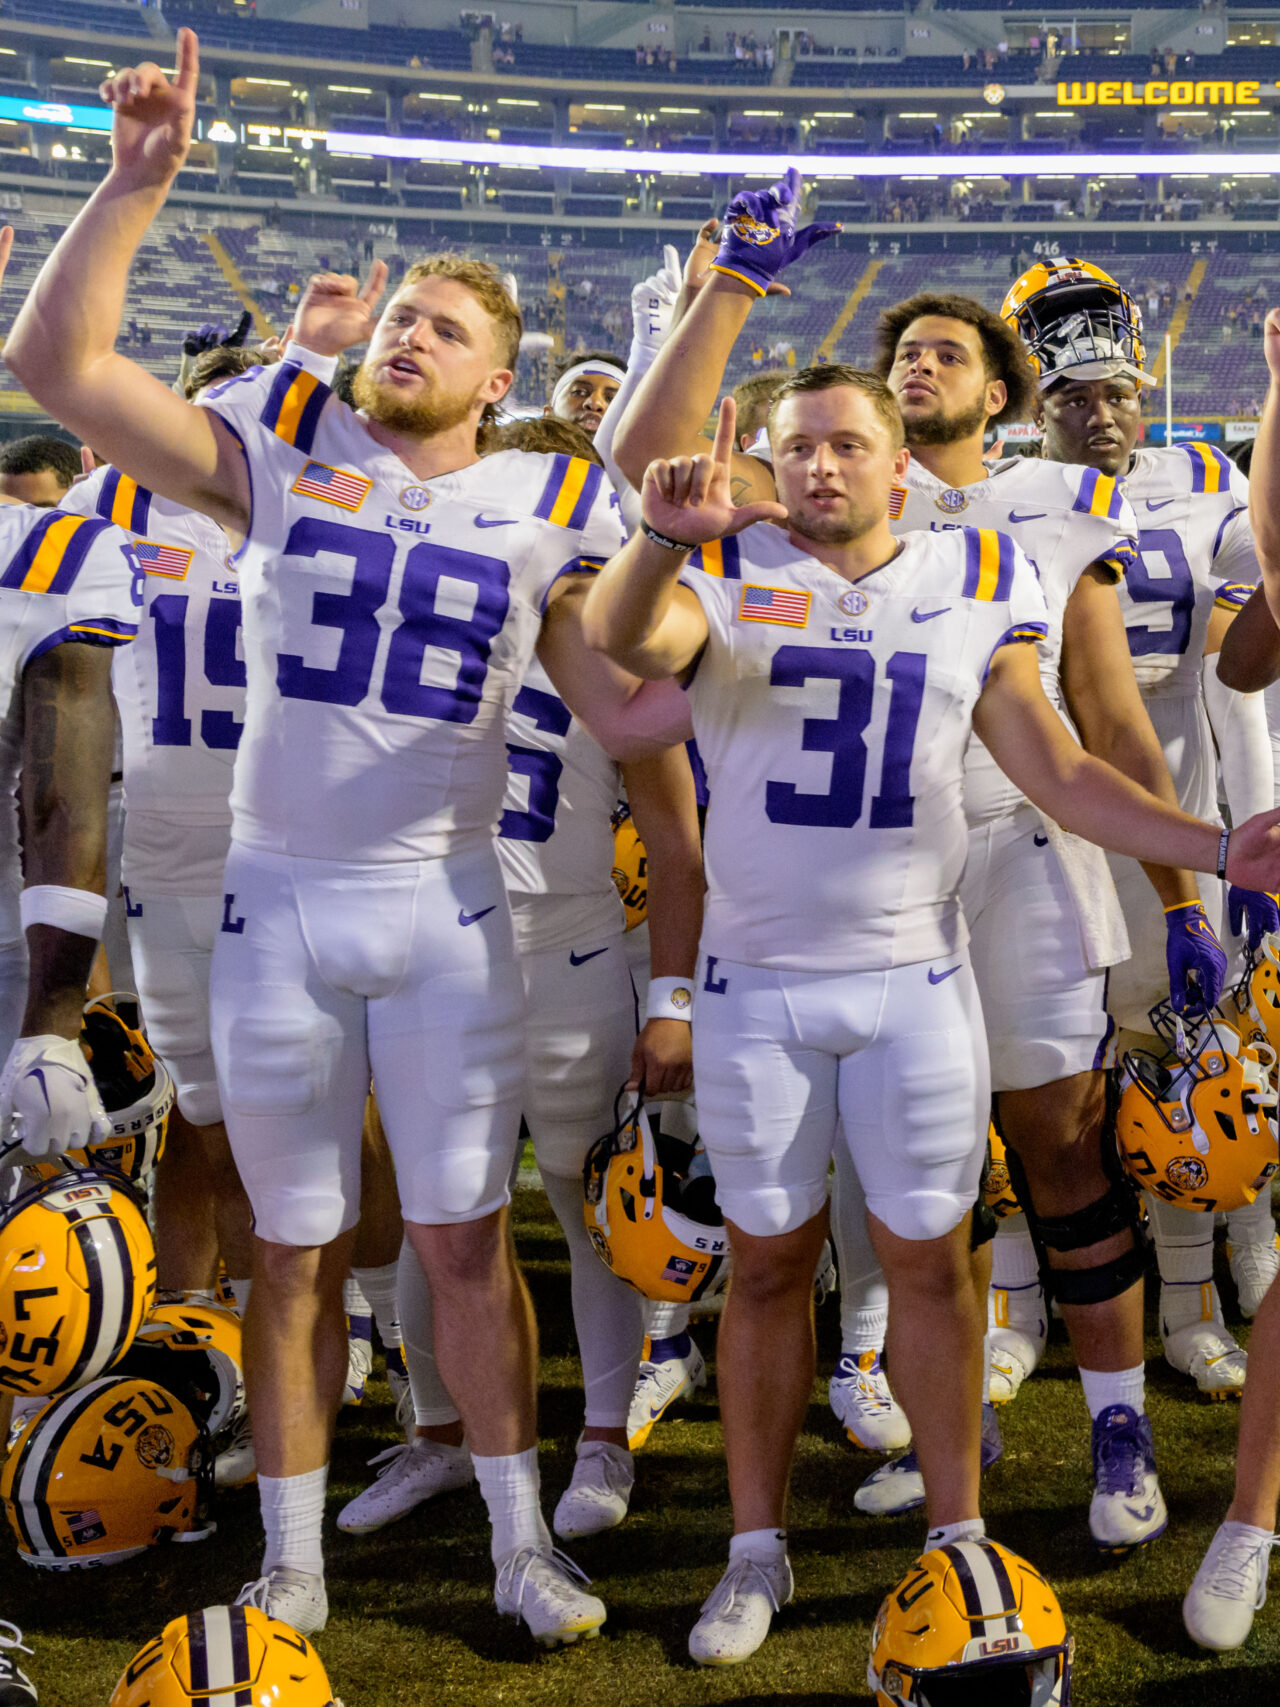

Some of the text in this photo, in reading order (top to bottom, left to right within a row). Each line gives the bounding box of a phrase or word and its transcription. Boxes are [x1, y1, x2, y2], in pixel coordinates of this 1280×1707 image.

[1057, 81, 1260, 105] WELCOME
[1033, 241, 1060, 256] 416
[943, 489, 964, 507] SEC
[385, 515, 431, 534] LSU
[647, 530, 674, 549] Psalm
[212, 581, 240, 595] LS
[277, 517, 510, 724] 38
[830, 627, 873, 643] LSU
[765, 645, 927, 828] 31
[1217, 836, 1228, 871] WEAKNESS
[224, 894, 244, 934] L
[704, 957, 727, 995] L
[114, 1093, 174, 1134] TIGERS
[64, 1187, 103, 1202] LSU
[80, 1389, 173, 1472] LSU
[62, 1536, 73, 1547] 5
[979, 1637, 1020, 1657] LSU
